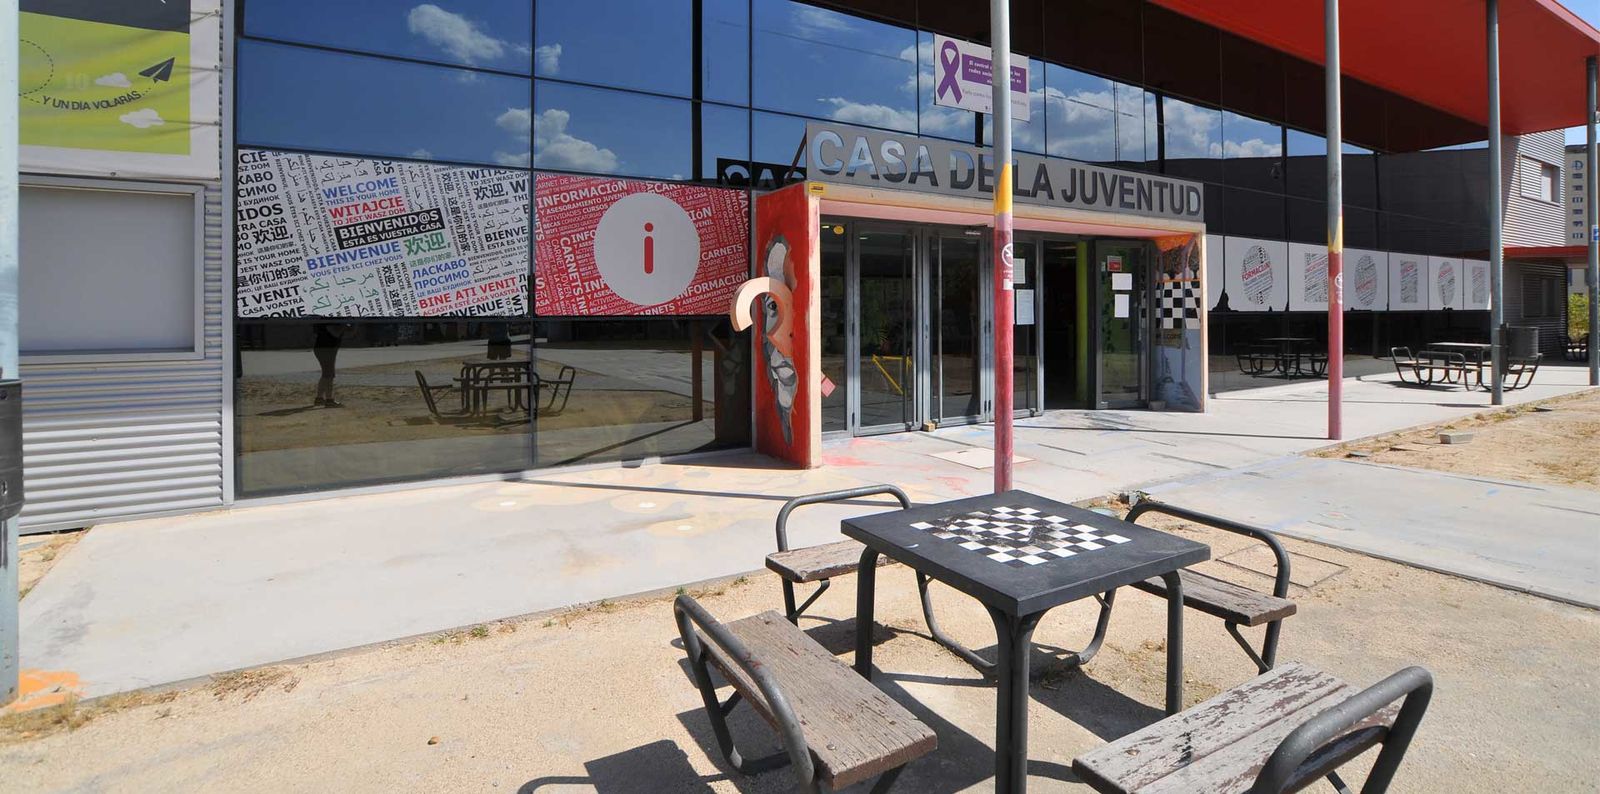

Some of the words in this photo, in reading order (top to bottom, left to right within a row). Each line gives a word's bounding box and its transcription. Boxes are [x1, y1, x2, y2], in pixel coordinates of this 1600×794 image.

[43, 95, 50, 104] Y
[52, 98, 70, 109] UN
[496, 174, 514, 182] WASZ
[812, 130, 939, 188] CASA
[950, 147, 994, 192] DE
[1012, 157, 1055, 200] LA
[1061, 167, 1201, 217] JUVENTUD
[322, 176, 399, 200] WELCOME
[326, 198, 345, 206] THIS
[346, 195, 354, 203] IS
[356, 192, 378, 201] YOUR
[379, 188, 401, 198] HOME
[328, 196, 404, 220] WITAJCIE
[346, 216, 364, 224] JEST
[364, 210, 387, 220] WASZ
[388, 207, 406, 216] DOM
[546, 198, 602, 214] ASESORAMIENTO
[582, 203, 608, 214] CURSOS
[259, 217, 288, 228] CASA
[339, 210, 439, 240] BIENVENID@S
[342, 238, 366, 248] ESTA
[367, 234, 378, 243] ES
[379, 226, 418, 240] VUESTRA
[420, 222, 442, 232] CASA
[254, 253, 276, 262] YOUR
[278, 248, 302, 258] HOME
[306, 241, 401, 270] BIENVENUE
[487, 242, 505, 250] ESTA
[702, 243, 744, 261] CARNETS
[260, 260, 283, 270] WASZ
[284, 256, 304, 264] DOM
[311, 269, 332, 278] VOUS
[364, 258, 382, 267] CHEZ
[384, 254, 404, 262] VOUS
[412, 258, 466, 280] ЛАСКАВО
[551, 239, 566, 270] CARNET
[560, 272, 572, 298] JOVEN
[560, 237, 584, 296] CARNETS
[414, 270, 470, 290] ПРОСИМО
[675, 270, 749, 300] NFORMACIóN
[252, 284, 300, 304] VENIT
[418, 292, 452, 310] BINE
[456, 287, 477, 300] ATI
[480, 276, 516, 294] VENIT
[682, 288, 728, 306] ASESORAMIENTO
[242, 306, 264, 316] CASA
[424, 304, 454, 316] ACEASTA
[472, 296, 490, 304] CASA
[634, 303, 676, 316] RNETS
